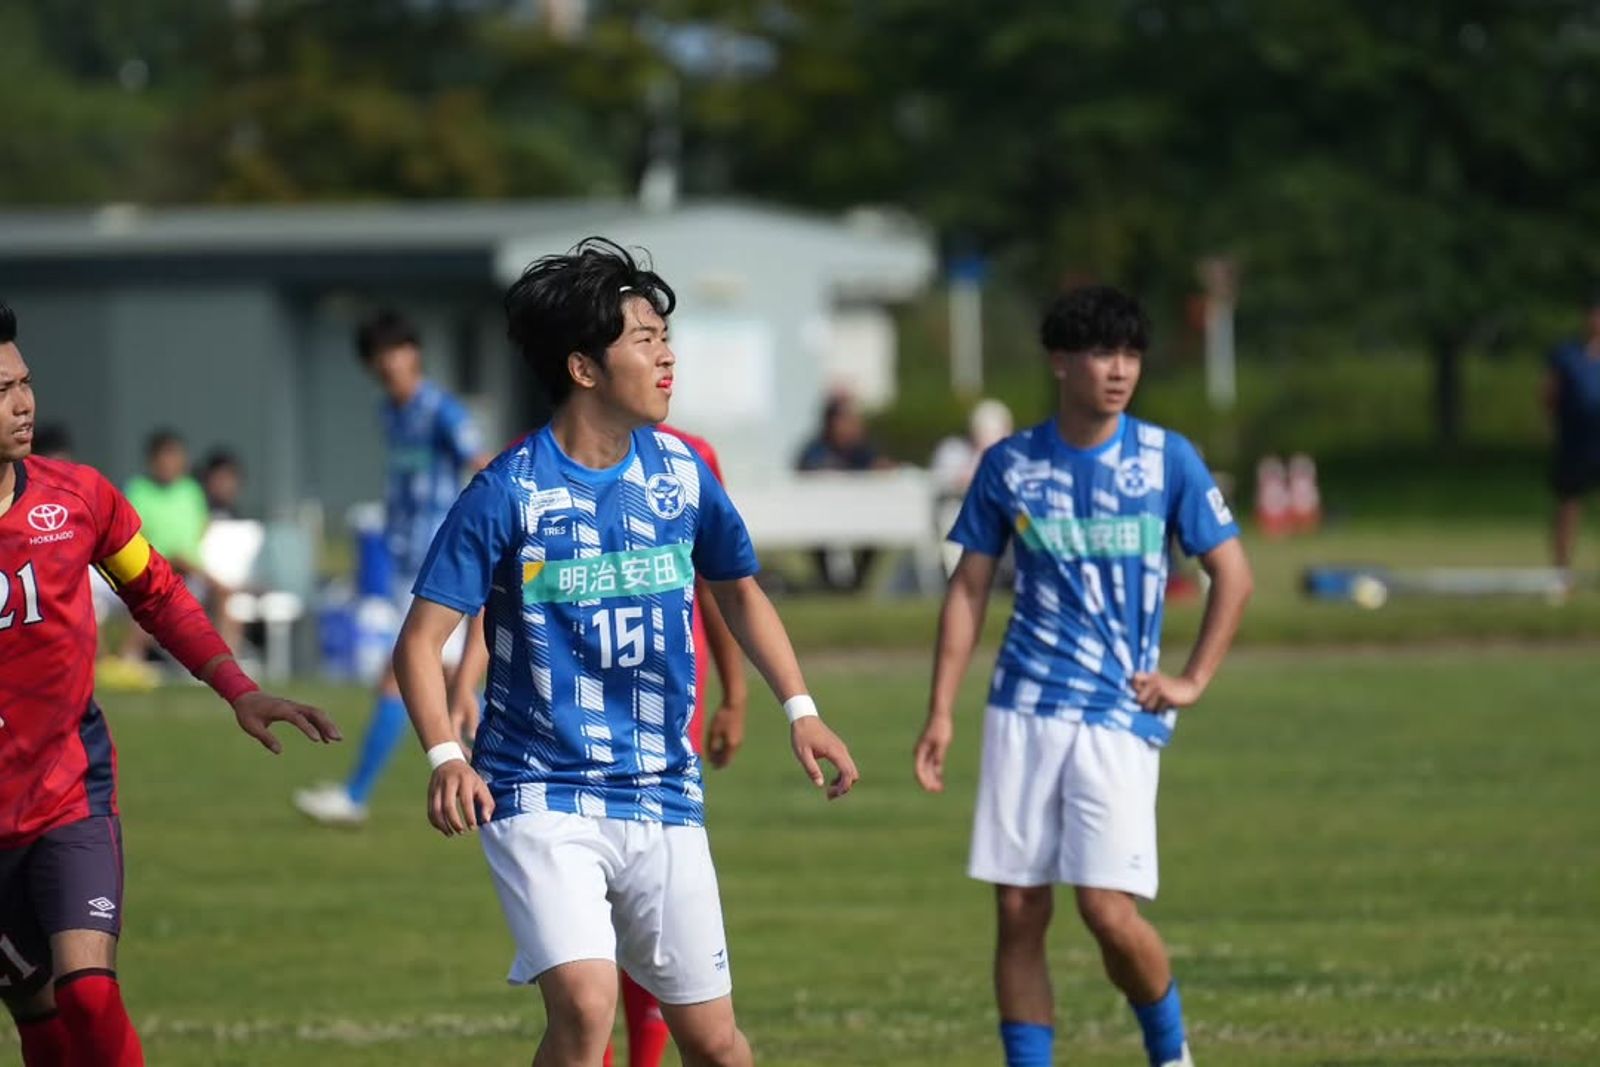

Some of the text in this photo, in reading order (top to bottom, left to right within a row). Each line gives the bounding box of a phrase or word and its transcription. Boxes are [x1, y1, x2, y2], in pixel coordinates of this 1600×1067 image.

[543, 526, 566, 536] TRES
[558, 552, 679, 595] 明治安田
[591, 606, 645, 669] 15
